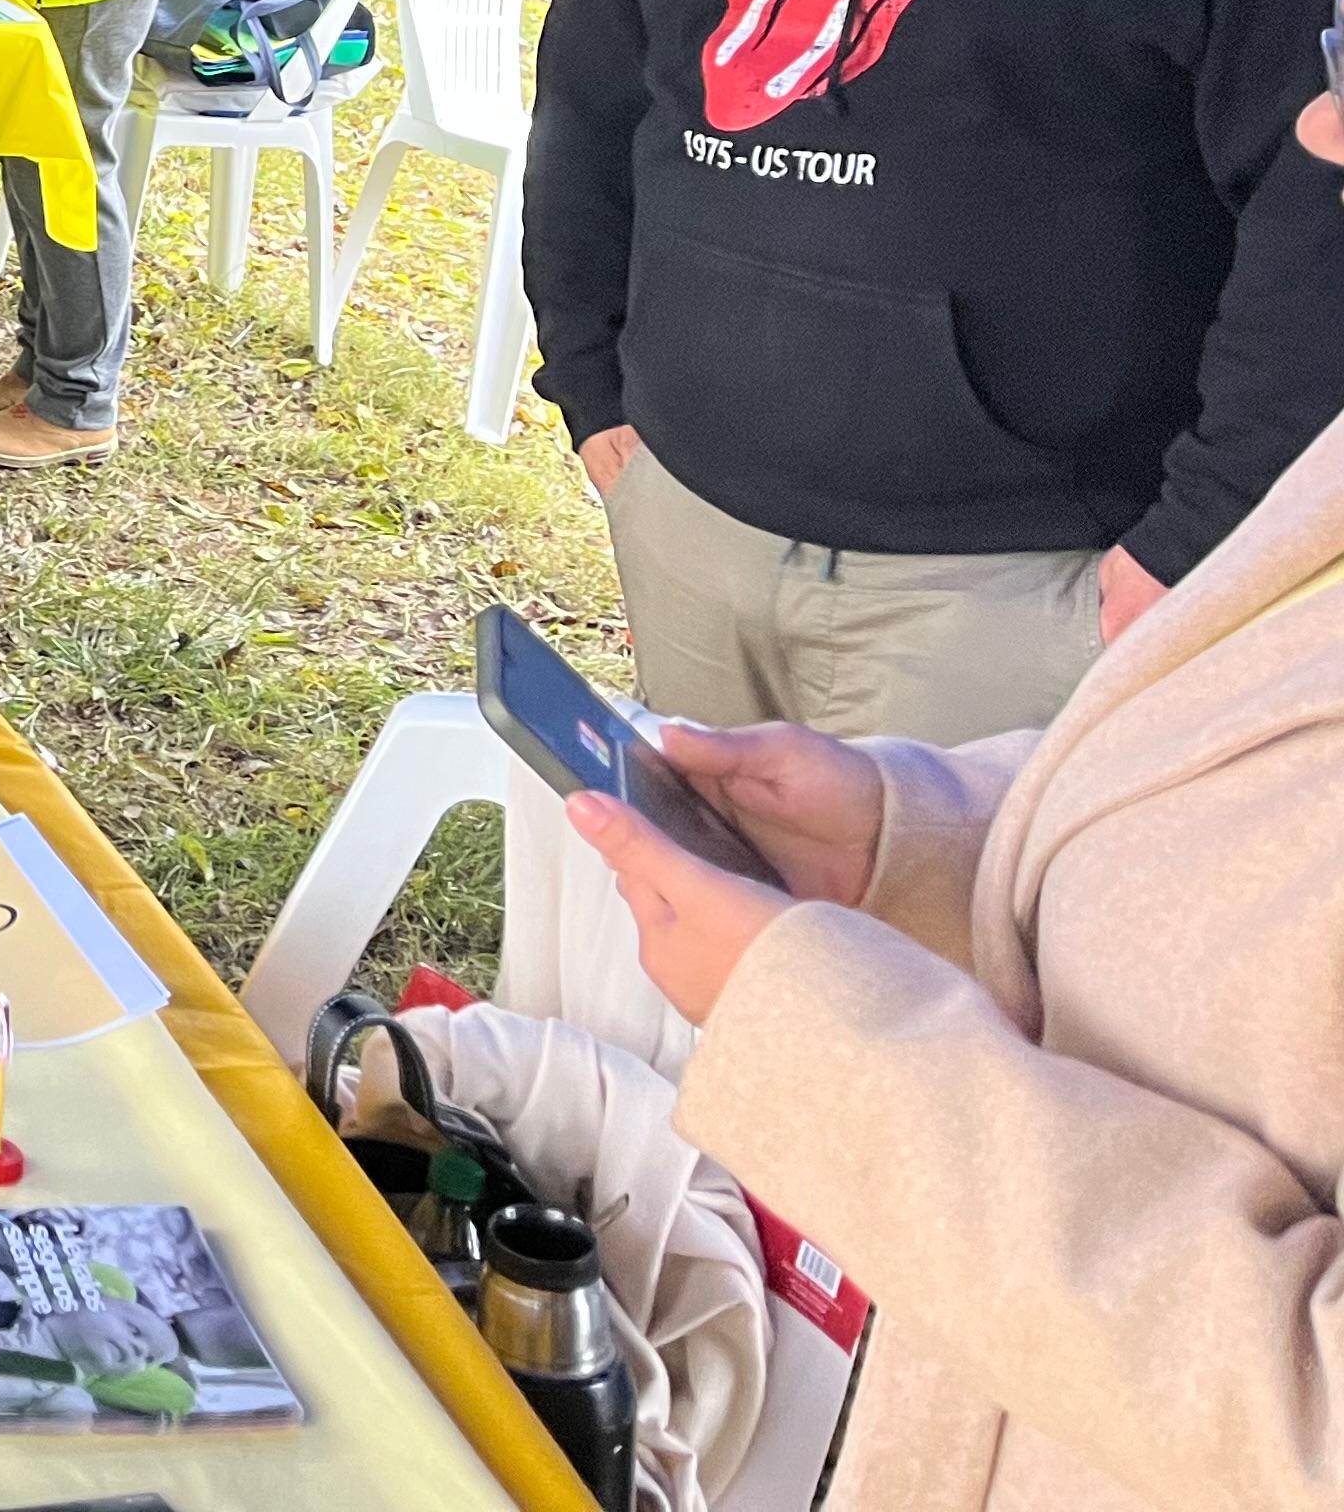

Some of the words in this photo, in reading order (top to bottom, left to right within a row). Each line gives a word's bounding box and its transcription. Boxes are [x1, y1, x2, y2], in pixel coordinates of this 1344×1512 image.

[683, 130, 734, 170] 1975
[751, 144, 790, 179] US
[791, 149, 877, 186] TOUR
[2, 1223, 53, 1316] siempre
[28, 1223, 80, 1313] seguros
